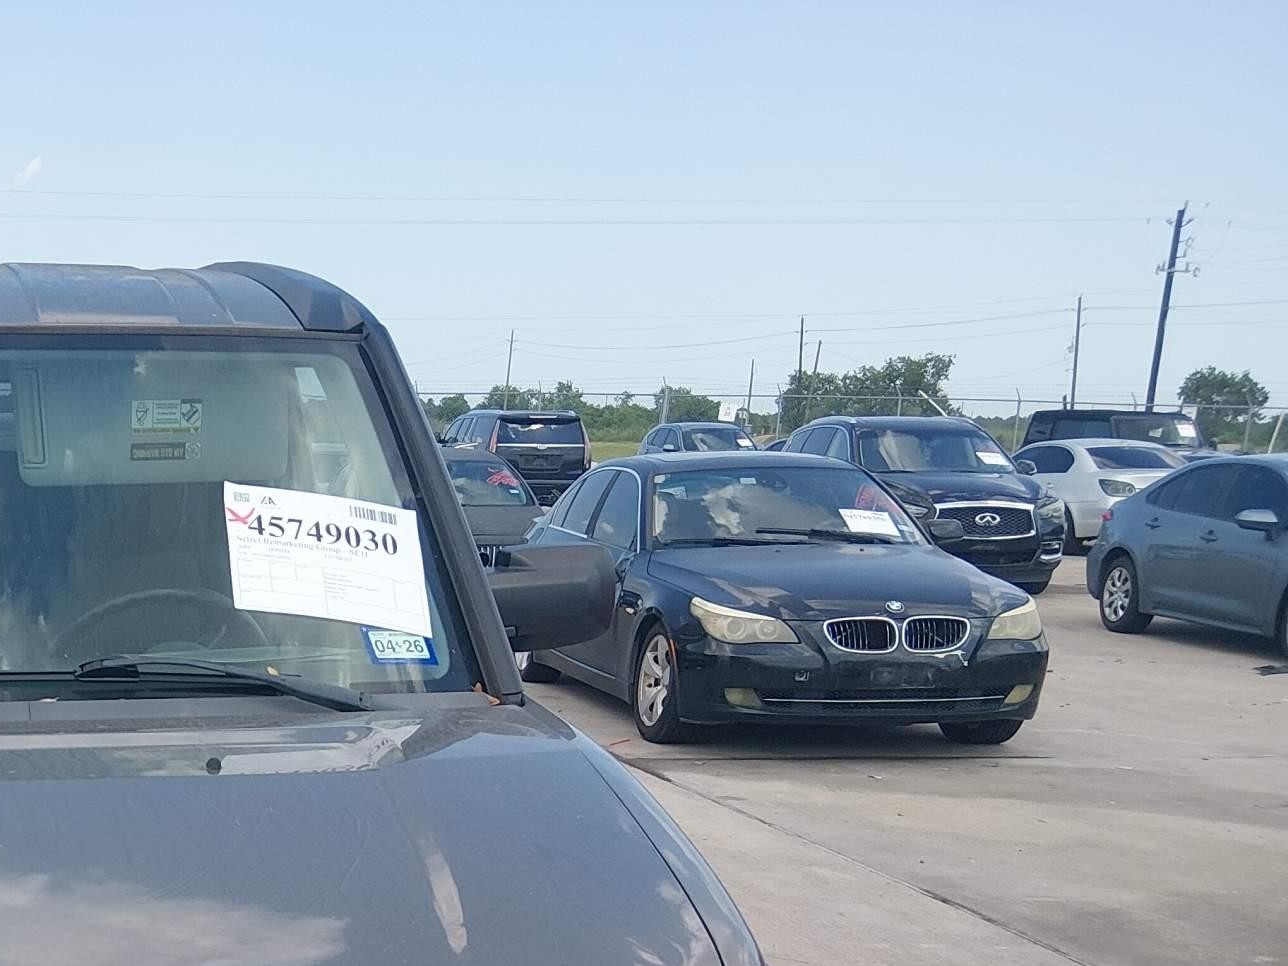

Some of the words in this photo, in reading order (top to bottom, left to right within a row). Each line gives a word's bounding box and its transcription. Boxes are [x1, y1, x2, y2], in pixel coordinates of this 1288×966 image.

[247, 513, 398, 556] 45749030
[237, 535, 261, 544] Select
[263, 537, 314, 551] Remarketing
[316, 544, 341, 554] Group
[374, 639, 396, 653] 04
[403, 639, 425, 653] 26
